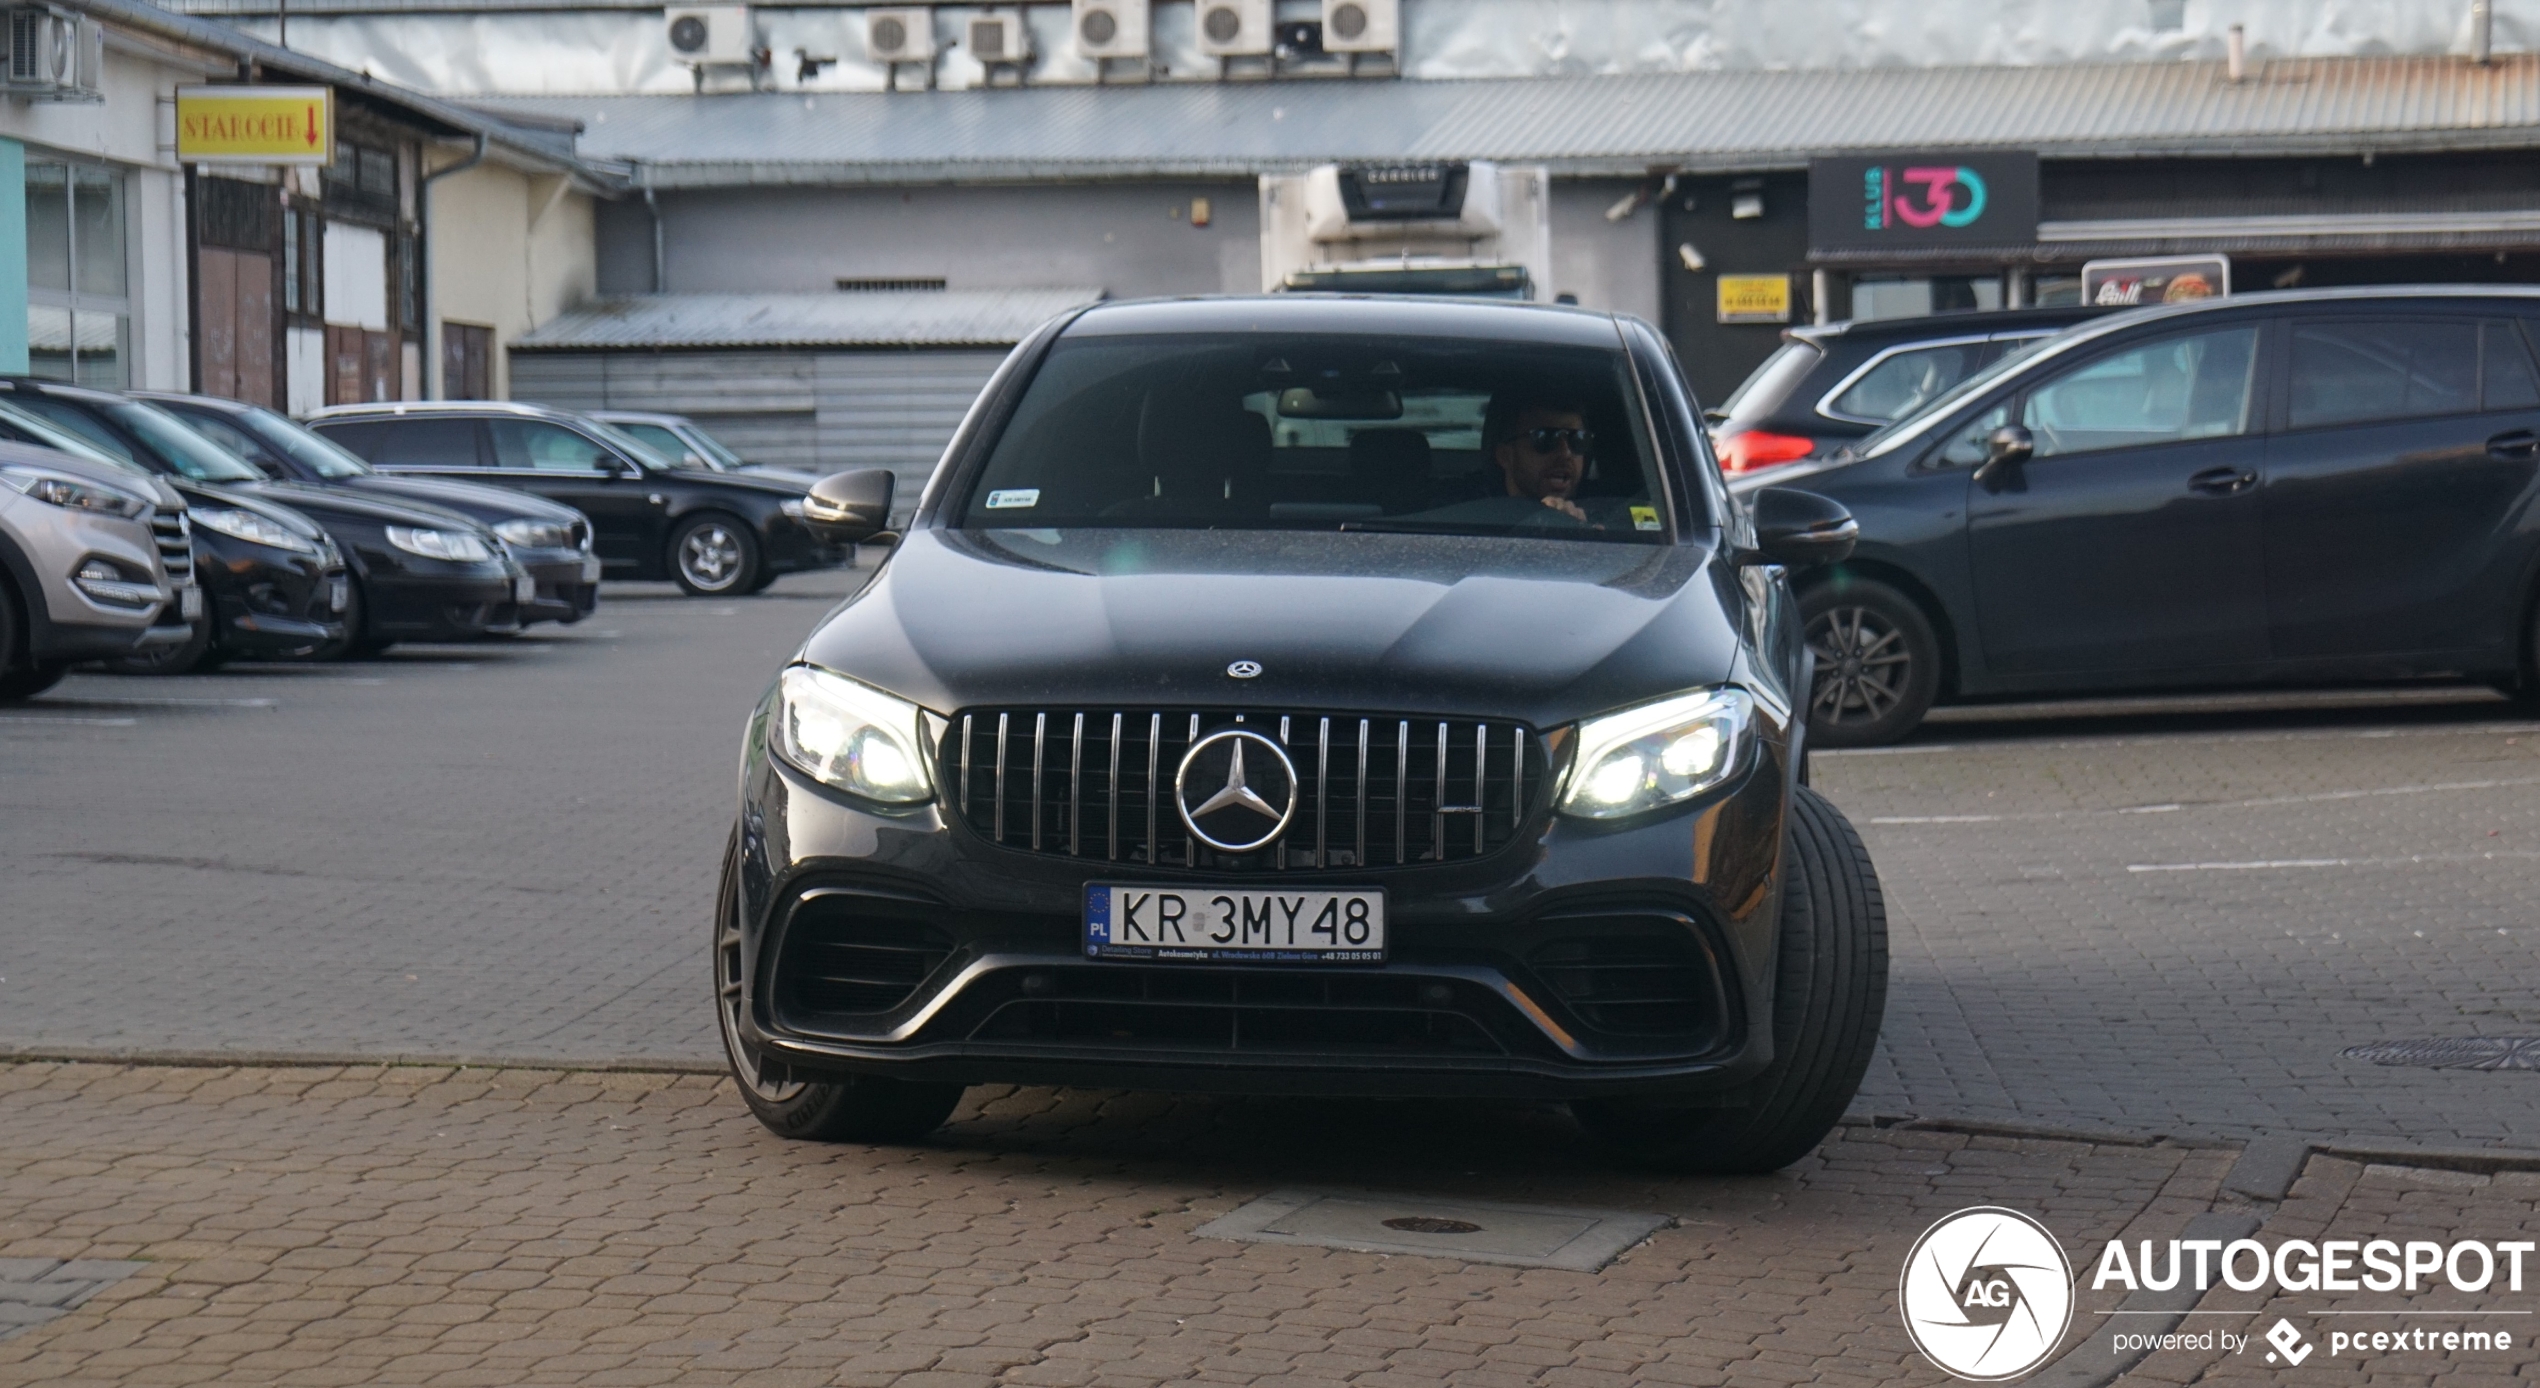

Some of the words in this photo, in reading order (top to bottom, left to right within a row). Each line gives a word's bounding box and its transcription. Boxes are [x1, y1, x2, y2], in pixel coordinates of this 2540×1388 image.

[184, 112, 300, 142] STAROCIE
[1864, 166, 1882, 230] KLUB
[1090, 923, 1108, 936] PL
[1123, 892, 1186, 942] KR
[1210, 895, 1370, 945] 3MY48
[1336, 952, 1350, 960] 733
[1351, 952, 1361, 960] 05
[1361, 952, 1371, 960] 05
[1372, 952, 1382, 960] 01
